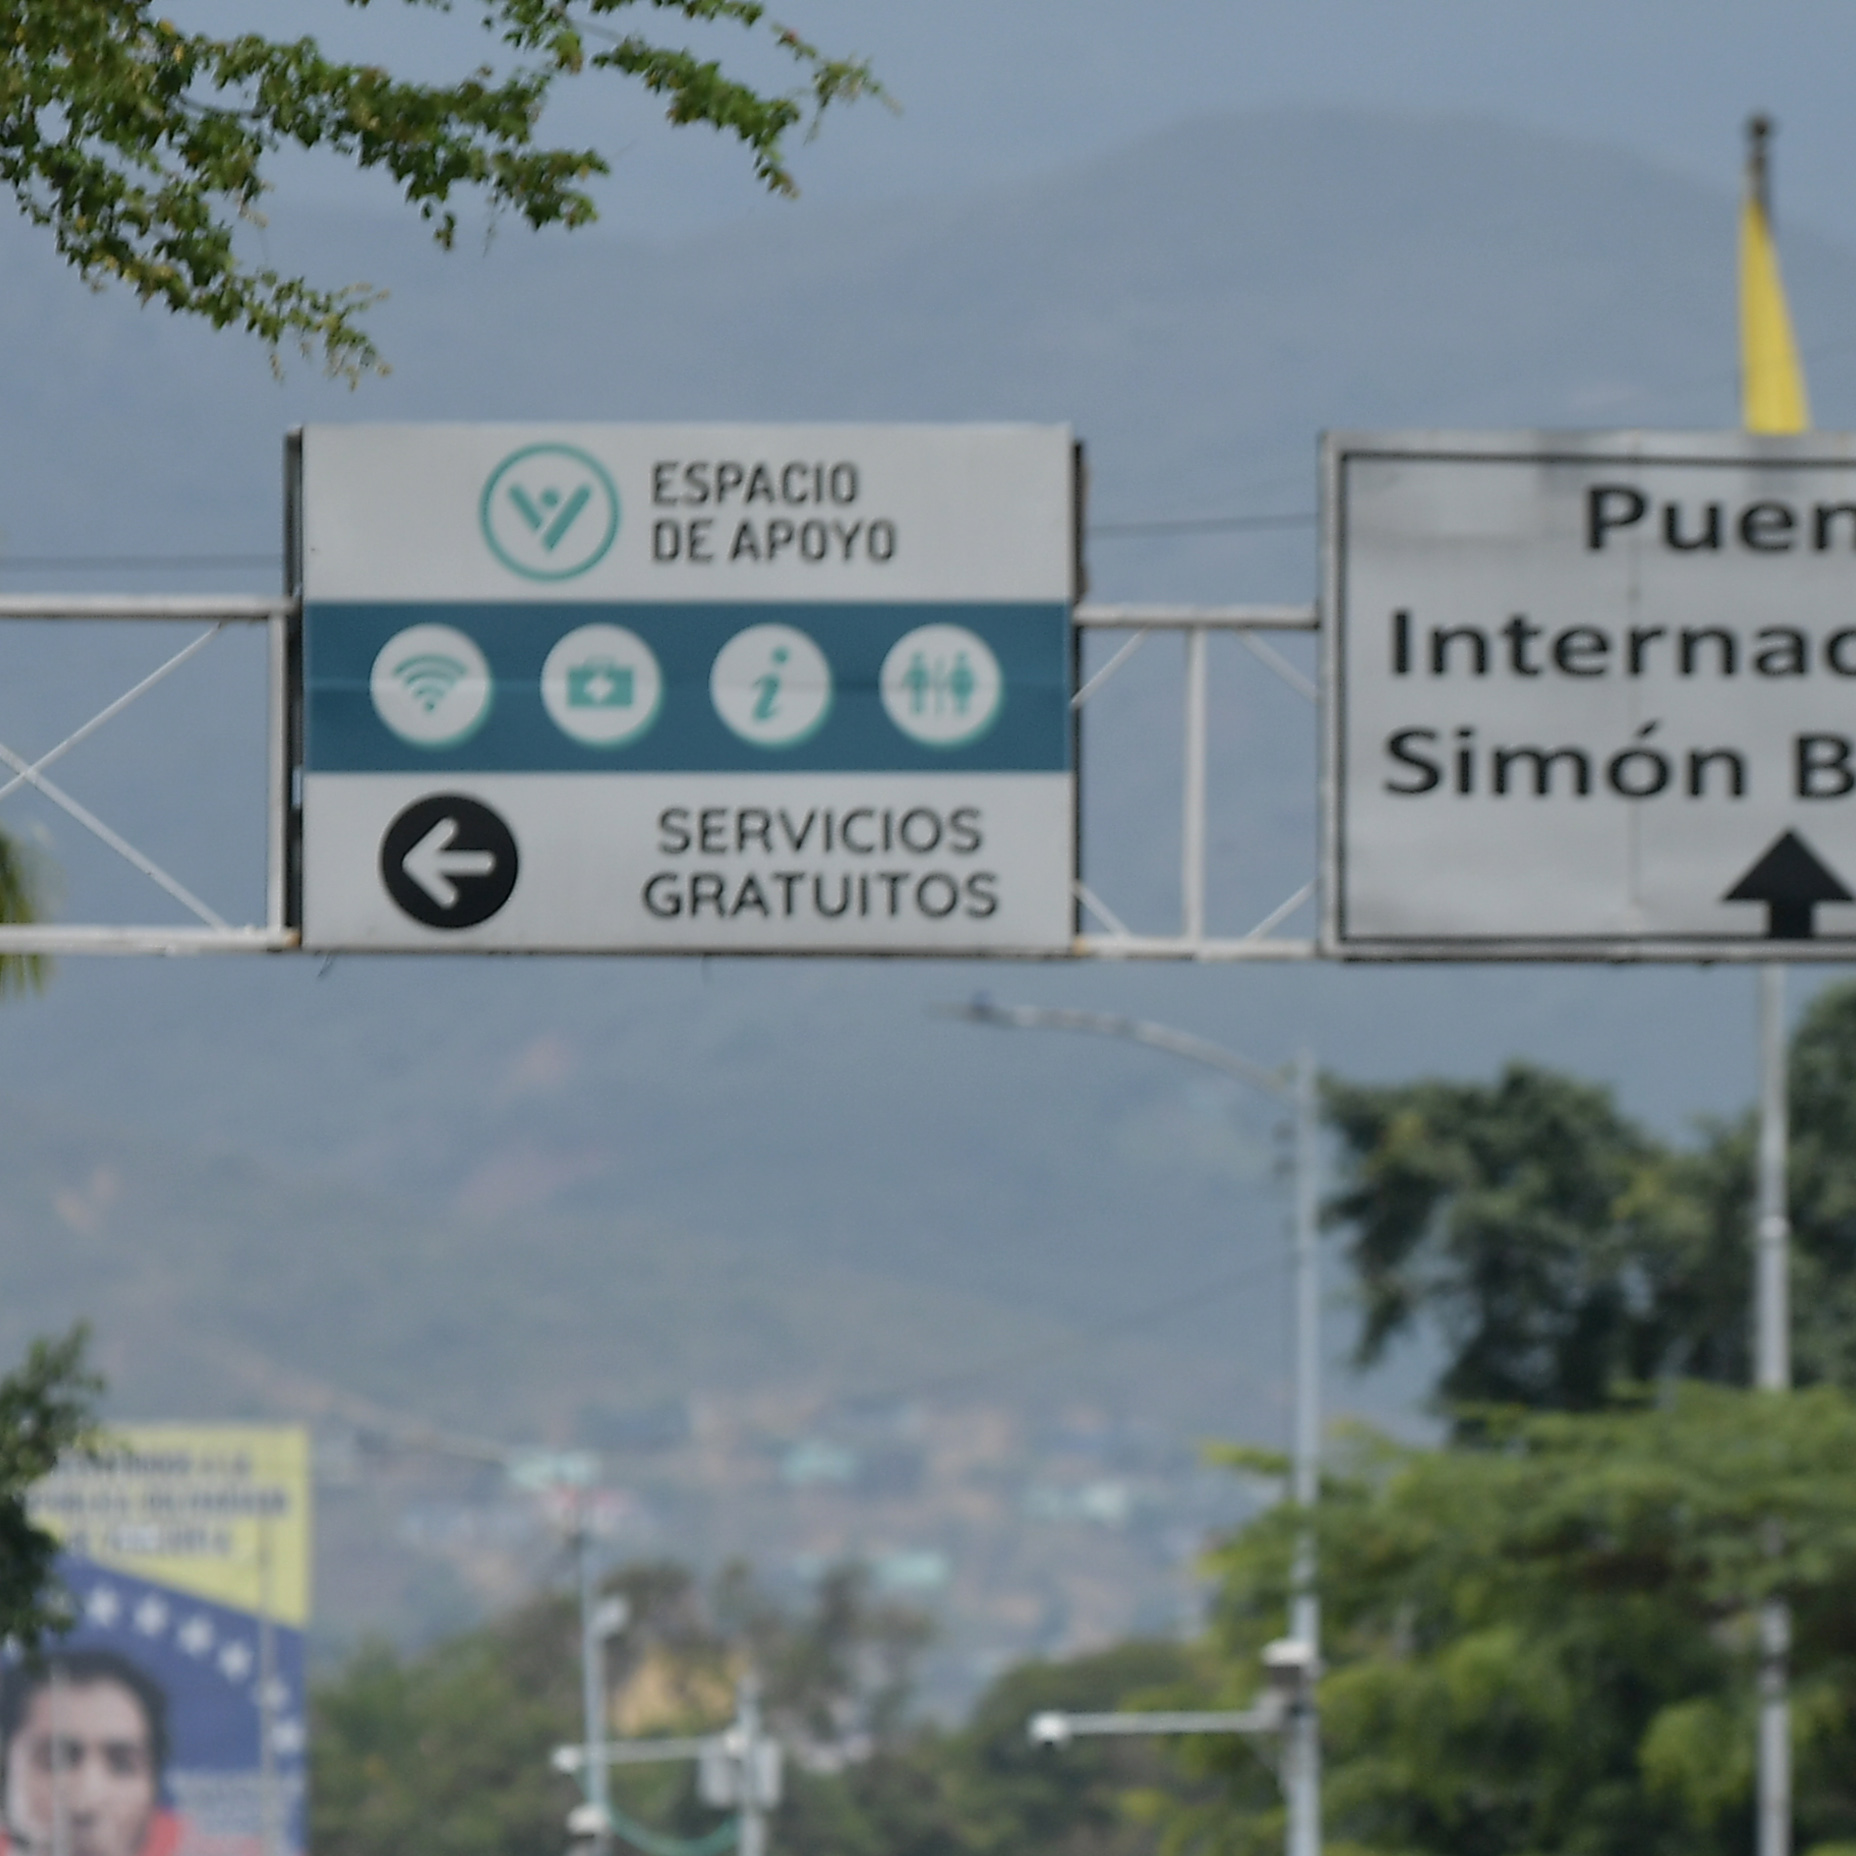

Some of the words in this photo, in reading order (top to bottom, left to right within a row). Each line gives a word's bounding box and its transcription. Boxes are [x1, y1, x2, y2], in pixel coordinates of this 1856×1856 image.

[651, 461, 860, 507] ESPACIO
[651, 519, 715, 563] DE
[729, 519, 898, 563] APOYO
[1383, 720, 1748, 797] Simón
[657, 807, 983, 856] SERVICIOS
[642, 872, 1000, 921] GRATUITOS
